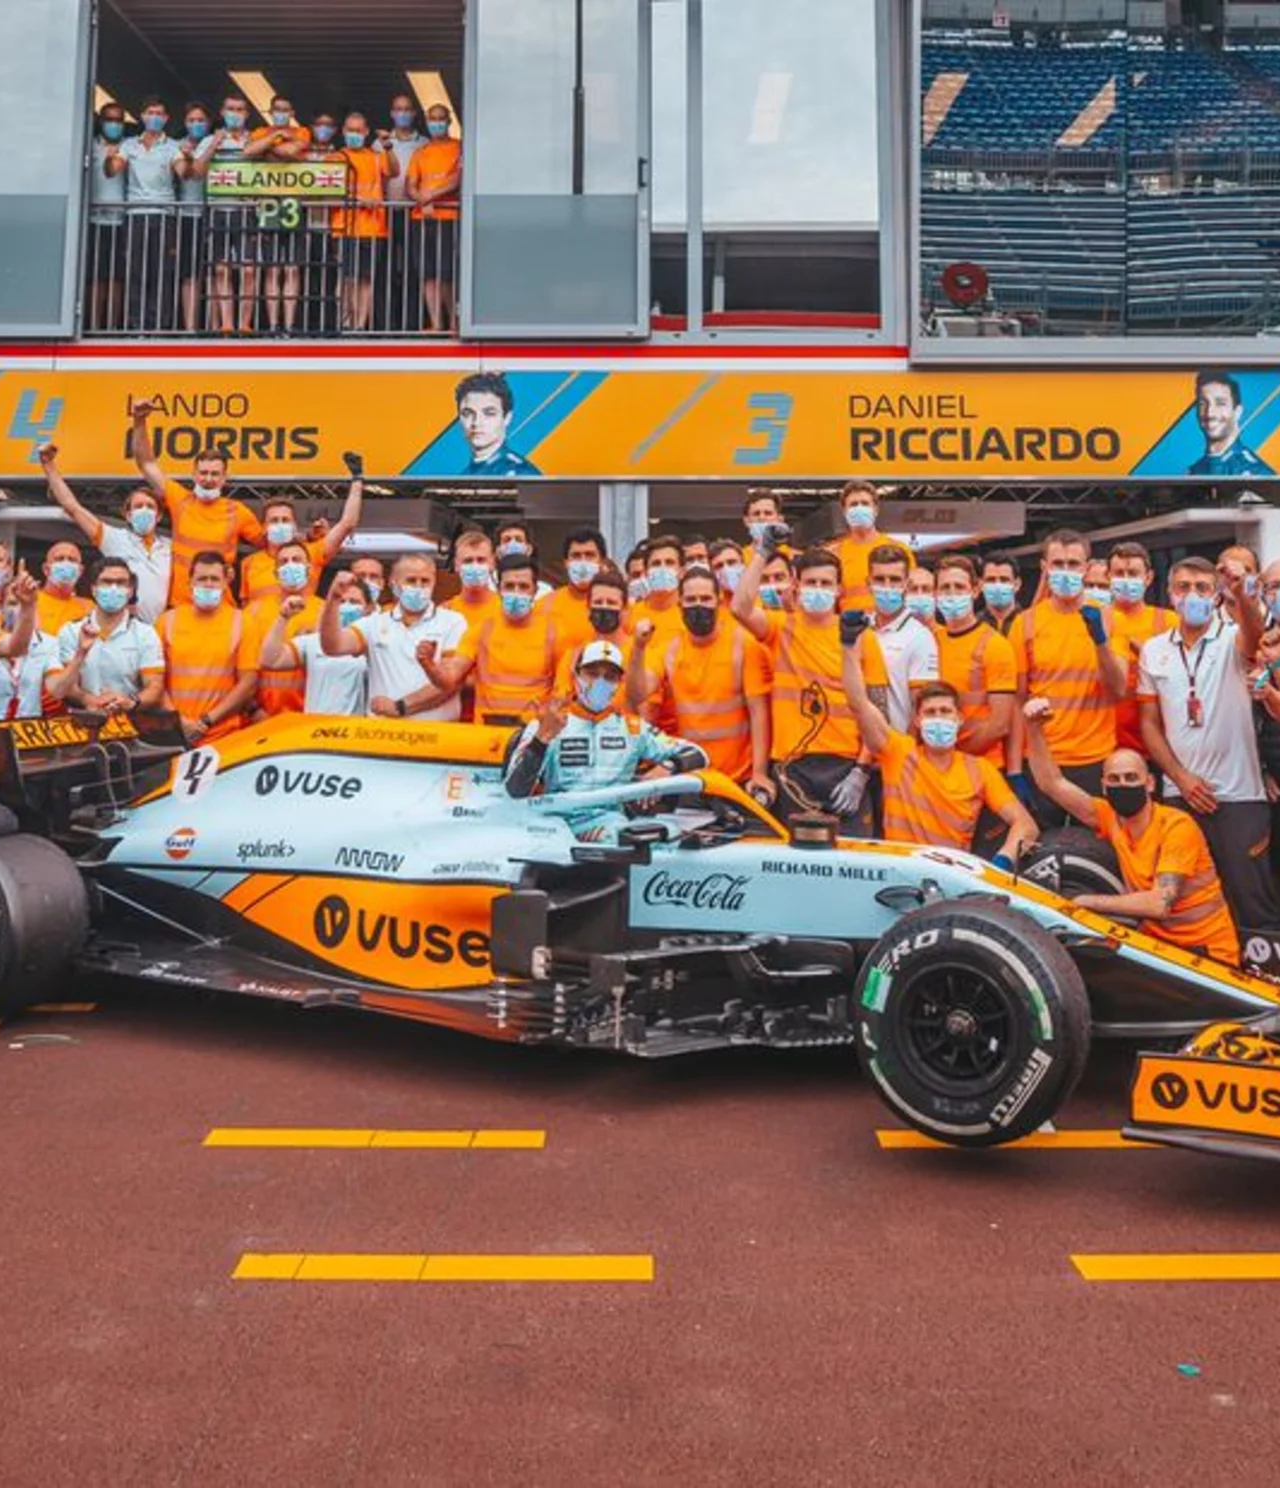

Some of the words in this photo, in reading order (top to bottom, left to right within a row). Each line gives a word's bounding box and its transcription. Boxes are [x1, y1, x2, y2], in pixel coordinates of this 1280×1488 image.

[236, 171, 316, 188] LANDO
[257, 198, 301, 229] P3
[127, 393, 250, 418] LANDO
[849, 395, 978, 419] DANIEL
[732, 391, 795, 466] 3
[849, 427, 1121, 461] RICCIARDO
[184, 751, 212, 795] 4
[283, 769, 363, 800] vuse
[761, 860, 833, 878] RICHARD
[839, 866, 888, 881] MILLE
[356, 909, 490, 969] vuse
